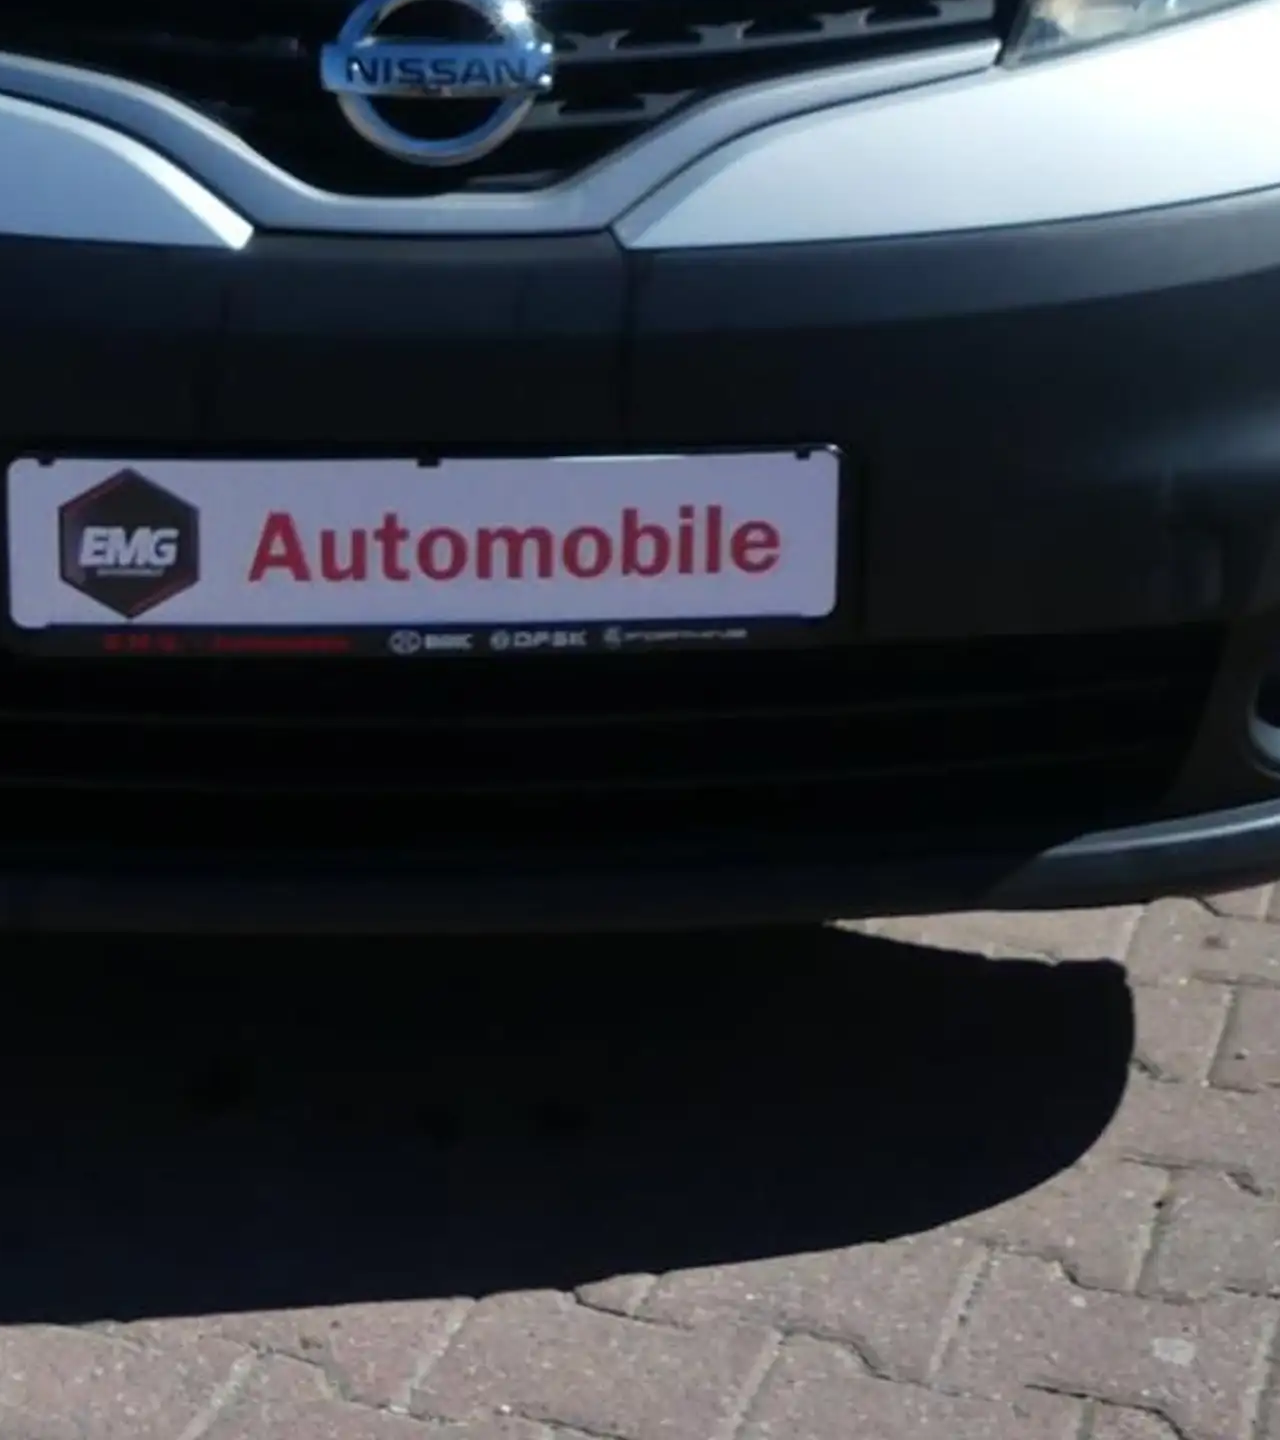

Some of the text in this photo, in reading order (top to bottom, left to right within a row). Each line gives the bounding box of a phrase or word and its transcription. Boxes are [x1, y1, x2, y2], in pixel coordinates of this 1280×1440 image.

[346, 57, 527, 84] NISSAN
[78, 502, 782, 583] EMG Automobile
